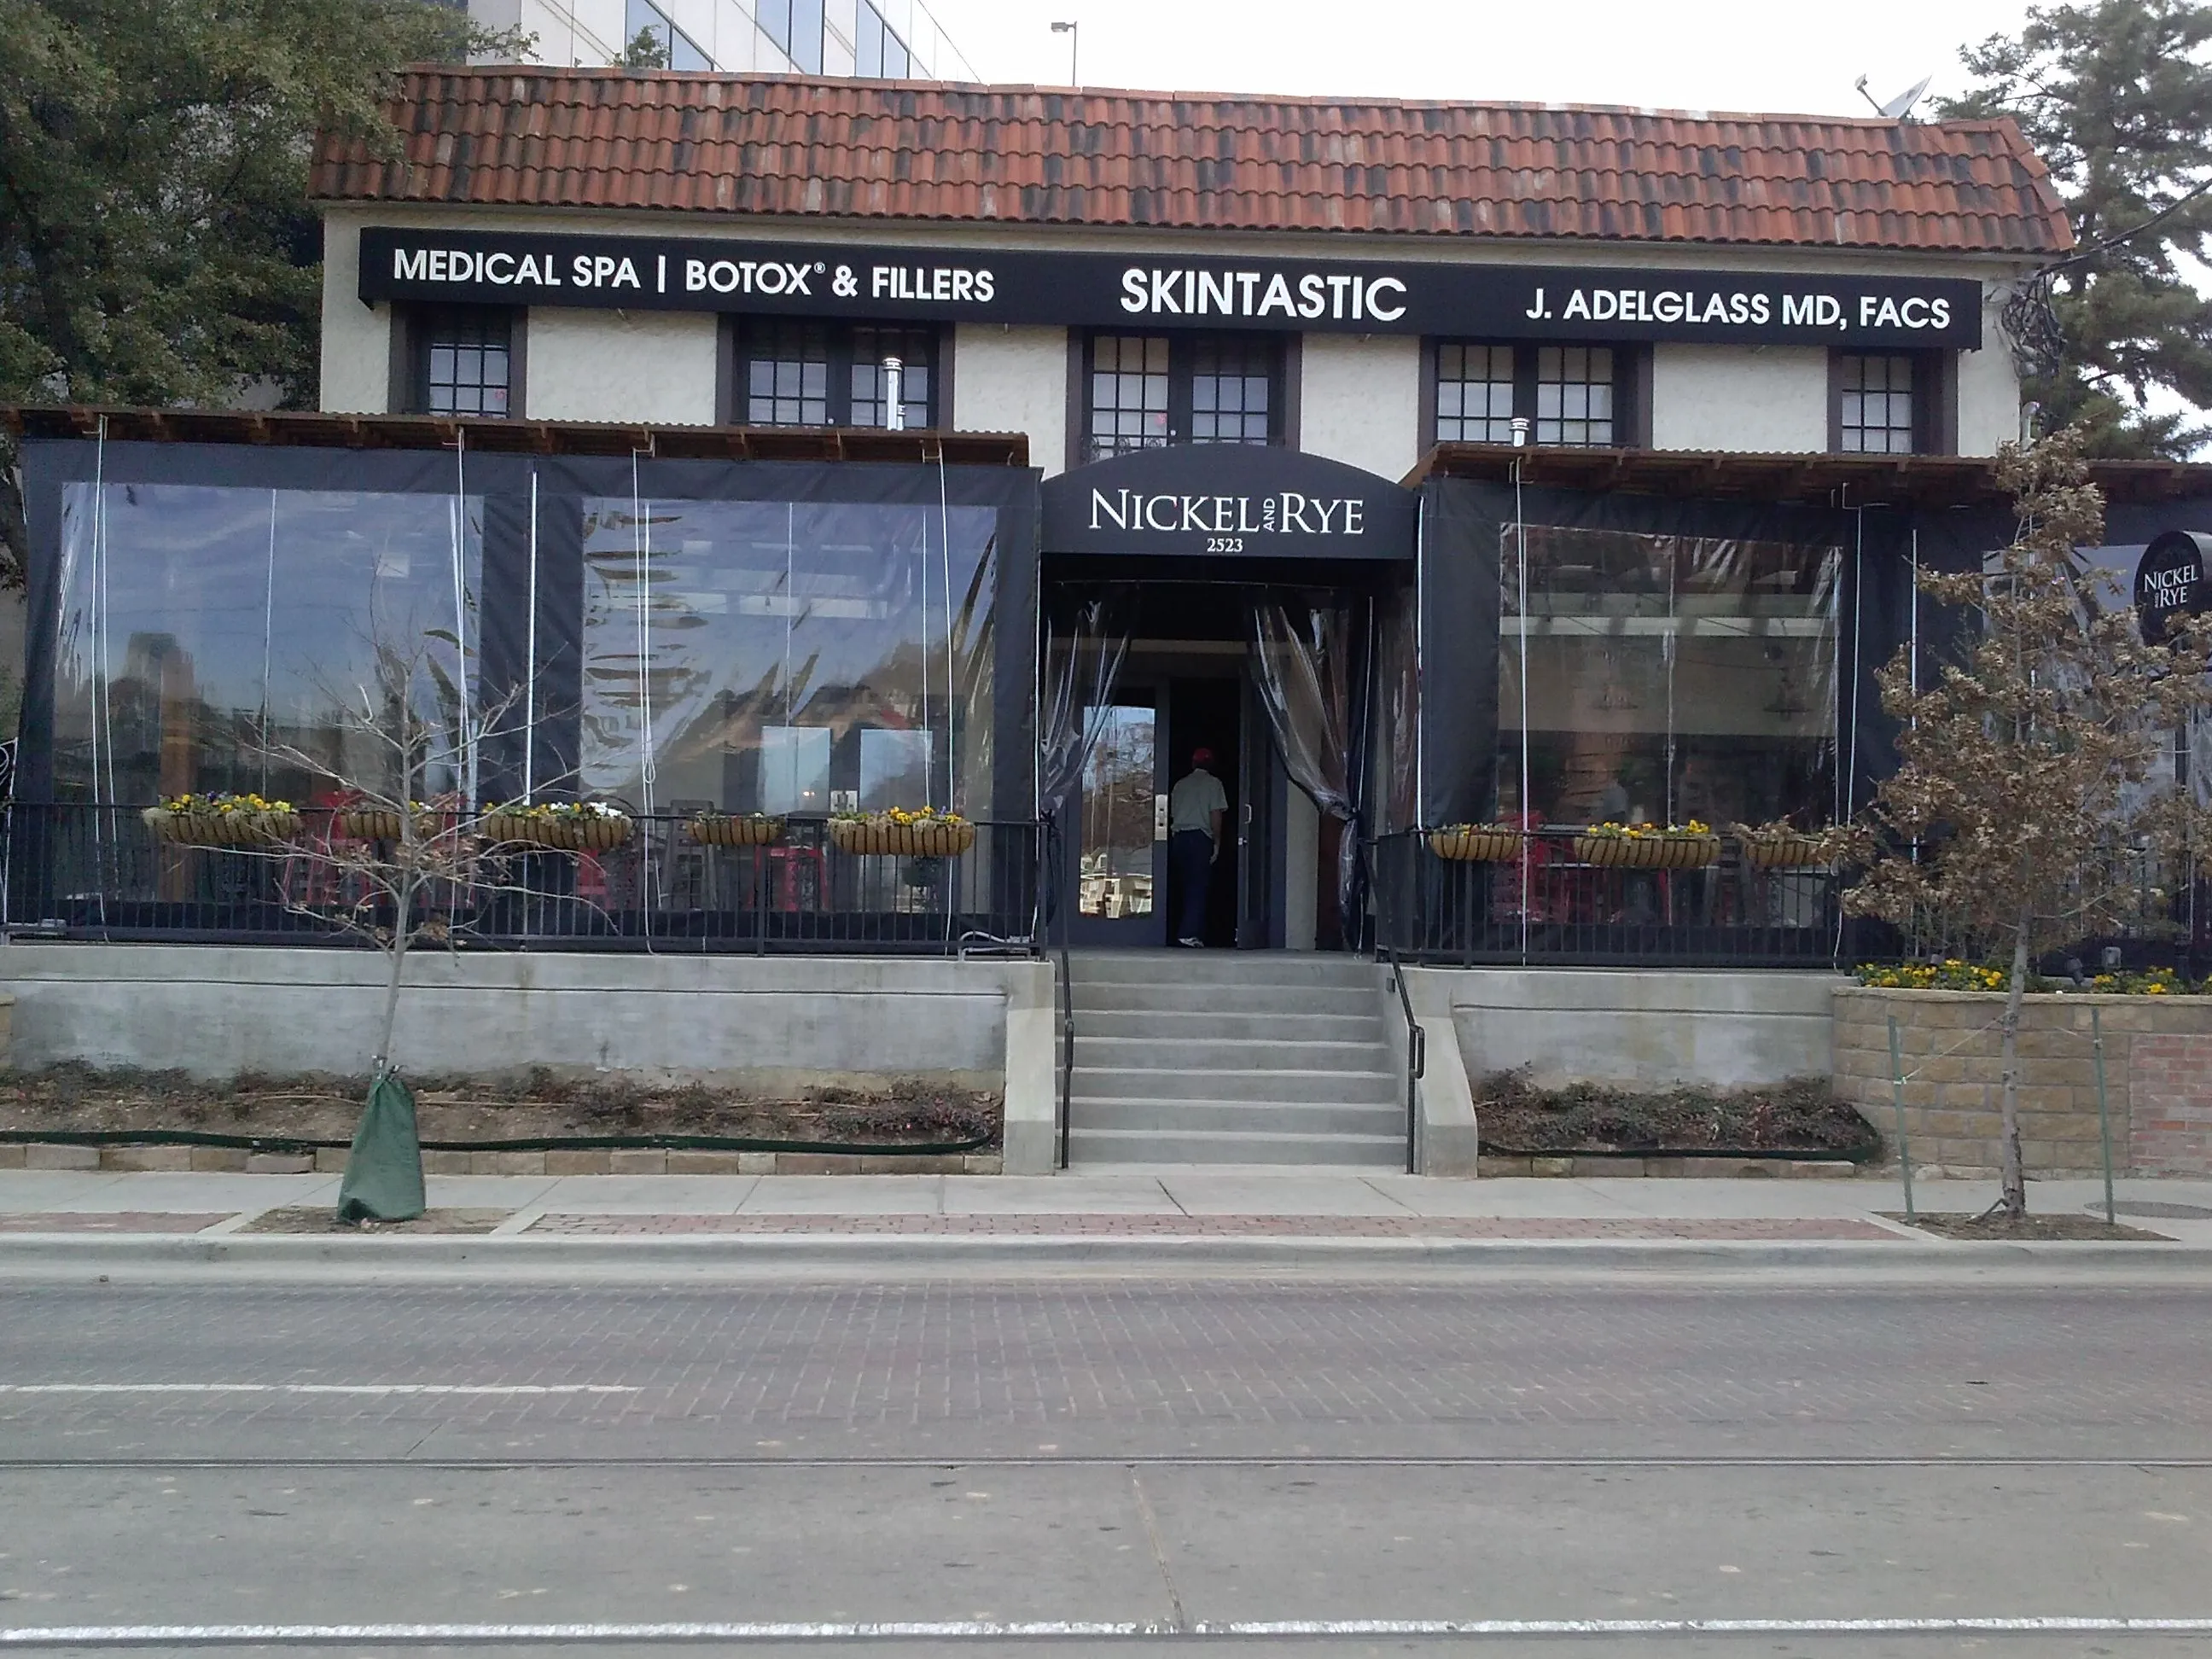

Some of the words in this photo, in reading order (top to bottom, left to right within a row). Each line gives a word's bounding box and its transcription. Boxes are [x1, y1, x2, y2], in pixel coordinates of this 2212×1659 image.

[393, 248, 562, 286] MEDICAL
[572, 255, 641, 288] SPA
[831, 265, 859, 297] &
[872, 266, 995, 302] FILLERS
[1120, 268, 1407, 322] SKINTASTIC
[1526, 288, 1551, 320] J.
[1563, 288, 1770, 324] ADELGLASS
[1782, 294, 1848, 331] MD,
[1860, 296, 1951, 329] FACS
[1088, 487, 1260, 533] NICKEL
[1262, 498, 1276, 533] AND
[1279, 492, 1365, 534] RYE
[1207, 538, 1243, 553] 2523
[2144, 564, 2198, 592] NICKEL
[2160, 585, 2187, 608] RYE
